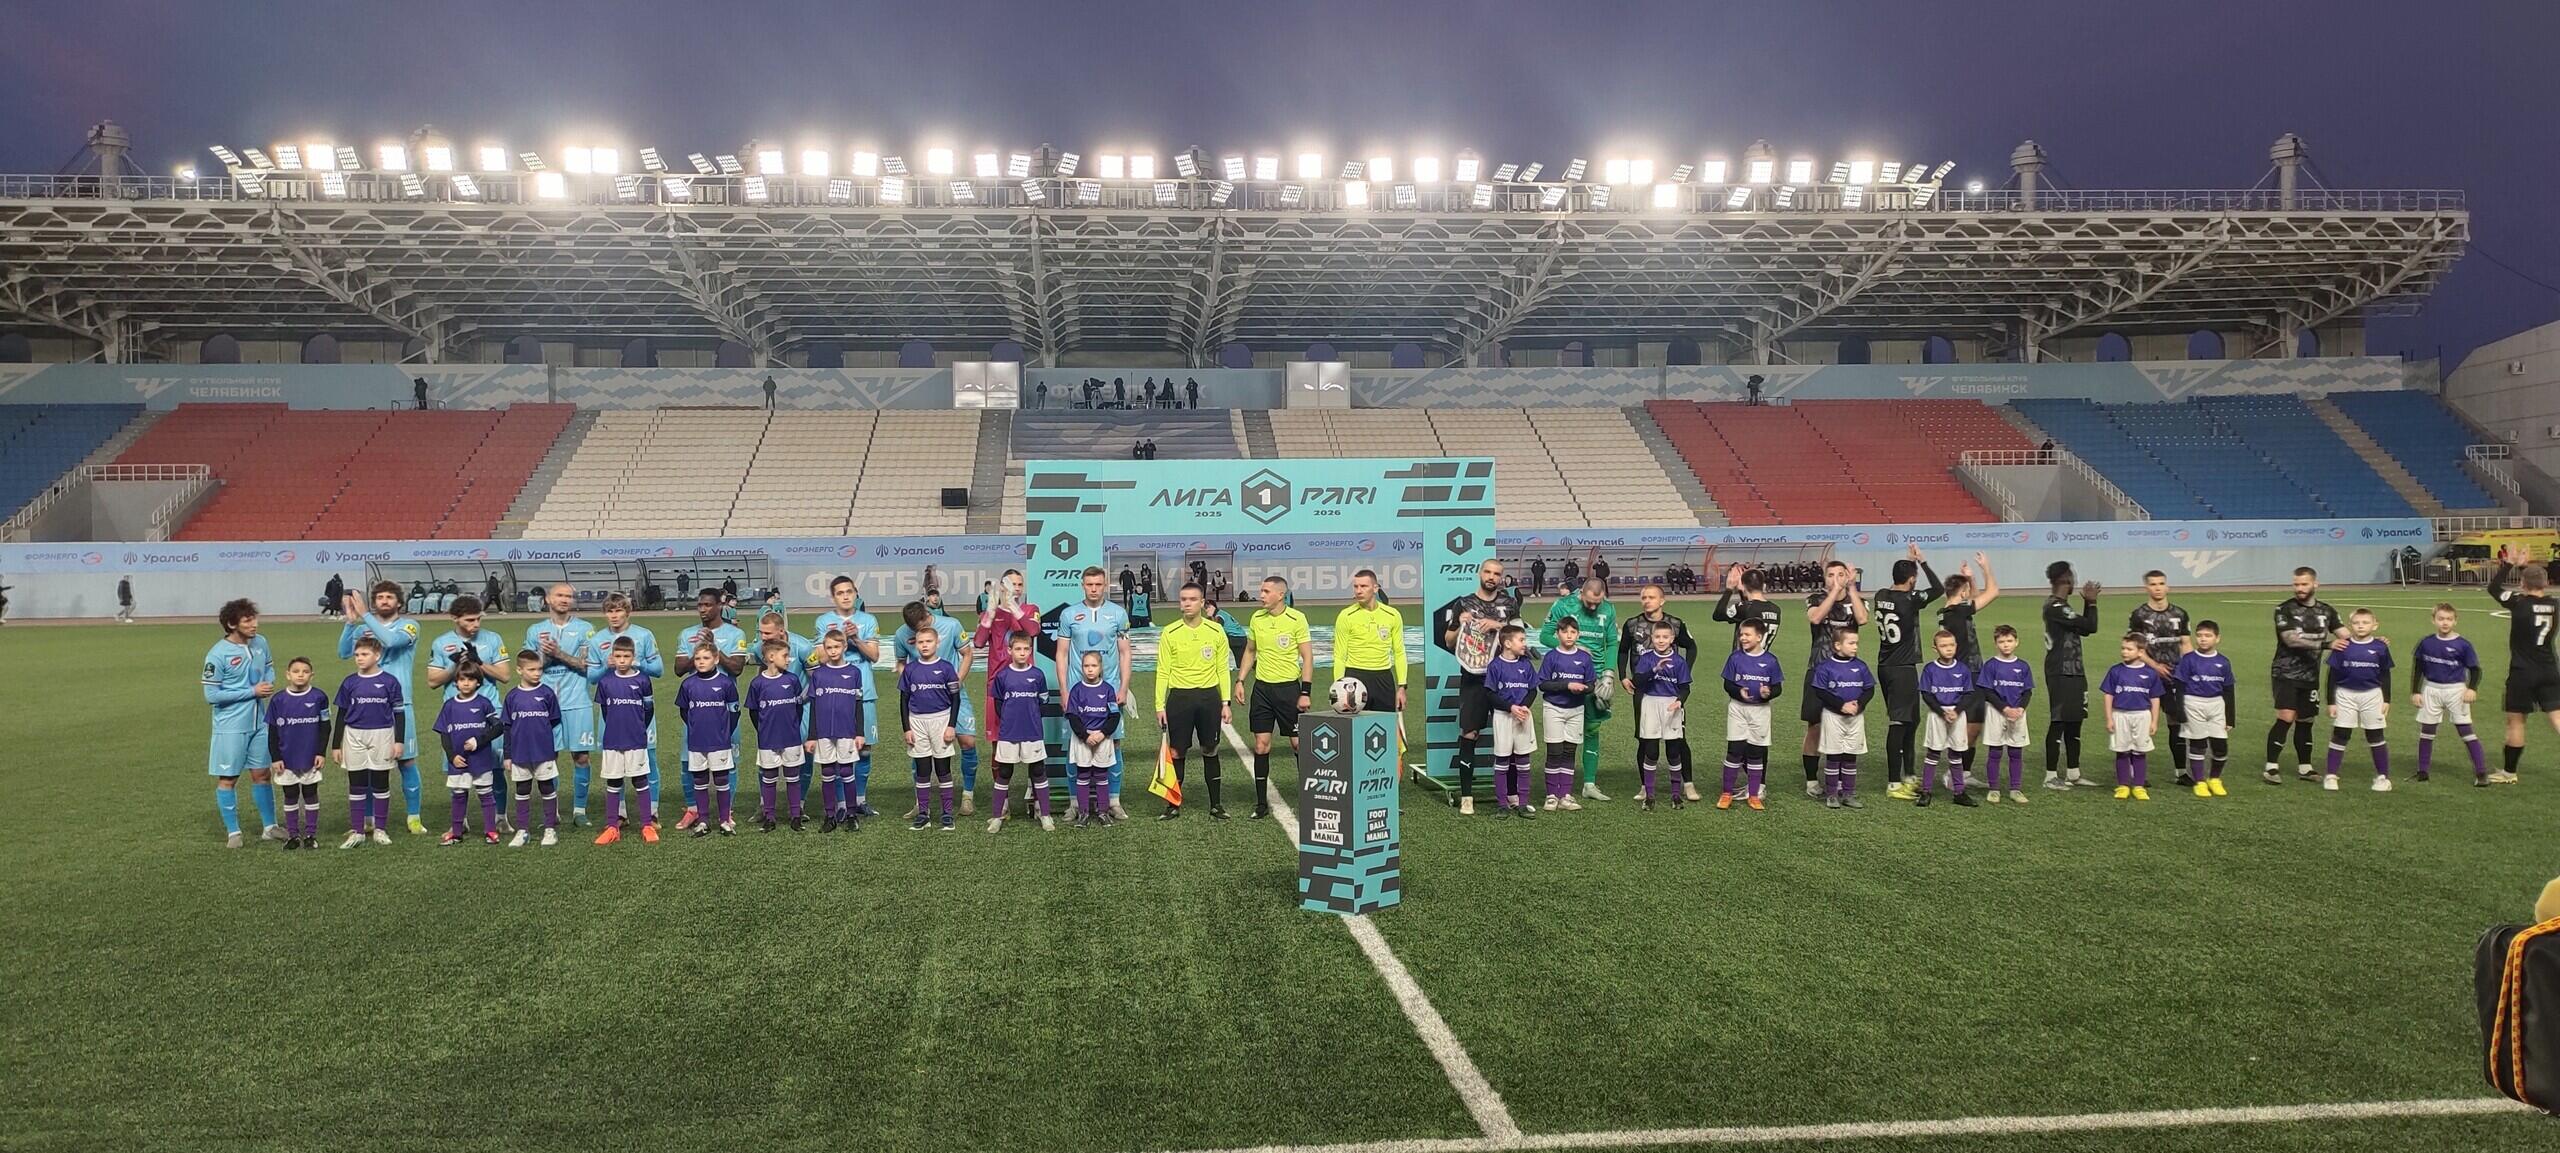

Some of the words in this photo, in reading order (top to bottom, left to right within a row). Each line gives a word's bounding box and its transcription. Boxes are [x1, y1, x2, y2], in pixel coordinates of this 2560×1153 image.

[189, 386, 281, 398] ЧЕЛЯБИНСК
[1951, 384, 2028, 394] ЧЕЛЯБИНСК
[1149, 488, 1233, 506] ЛИГА
[1300, 487, 1377, 505] PARI
[2062, 532, 2109, 542] Уралсиб
[2222, 530, 2268, 540] Уралсиб
[2376, 528, 2422, 538] Уралсиб
[1902, 534, 1950, 543] Уралсиб
[894, 546, 945, 556] Уралсиб
[1139, 542, 1186, 550] ФОРЭНЕРГО
[1242, 542, 1291, 551] Уралсиб
[334, 552, 391, 562] Уралсиб
[527, 550, 582, 560] Уралсиб
[600, 548, 650, 556] ФОРЭНЕРГО
[142, 553, 200, 564] Уралсиб
[2535, 615, 2553, 645] 7
[580, 732, 594, 746] 46
[1321, 737, 1328, 749] 1
[1372, 736, 1378, 748] 1
[1314, 768, 1338, 778] ЛИГА
[1367, 767, 1386, 776] ЛИГА
[1304, 778, 1348, 795] PARI
[1358, 776, 1394, 794] PARI
[1318, 811, 1338, 820] FOOT
[1369, 809, 1386, 818] FOOT
[1318, 822, 1336, 830] BALL
[1370, 820, 1385, 830] BALL
[1314, 833, 1340, 843] MANIA
[1366, 831, 1389, 842] MANIA
